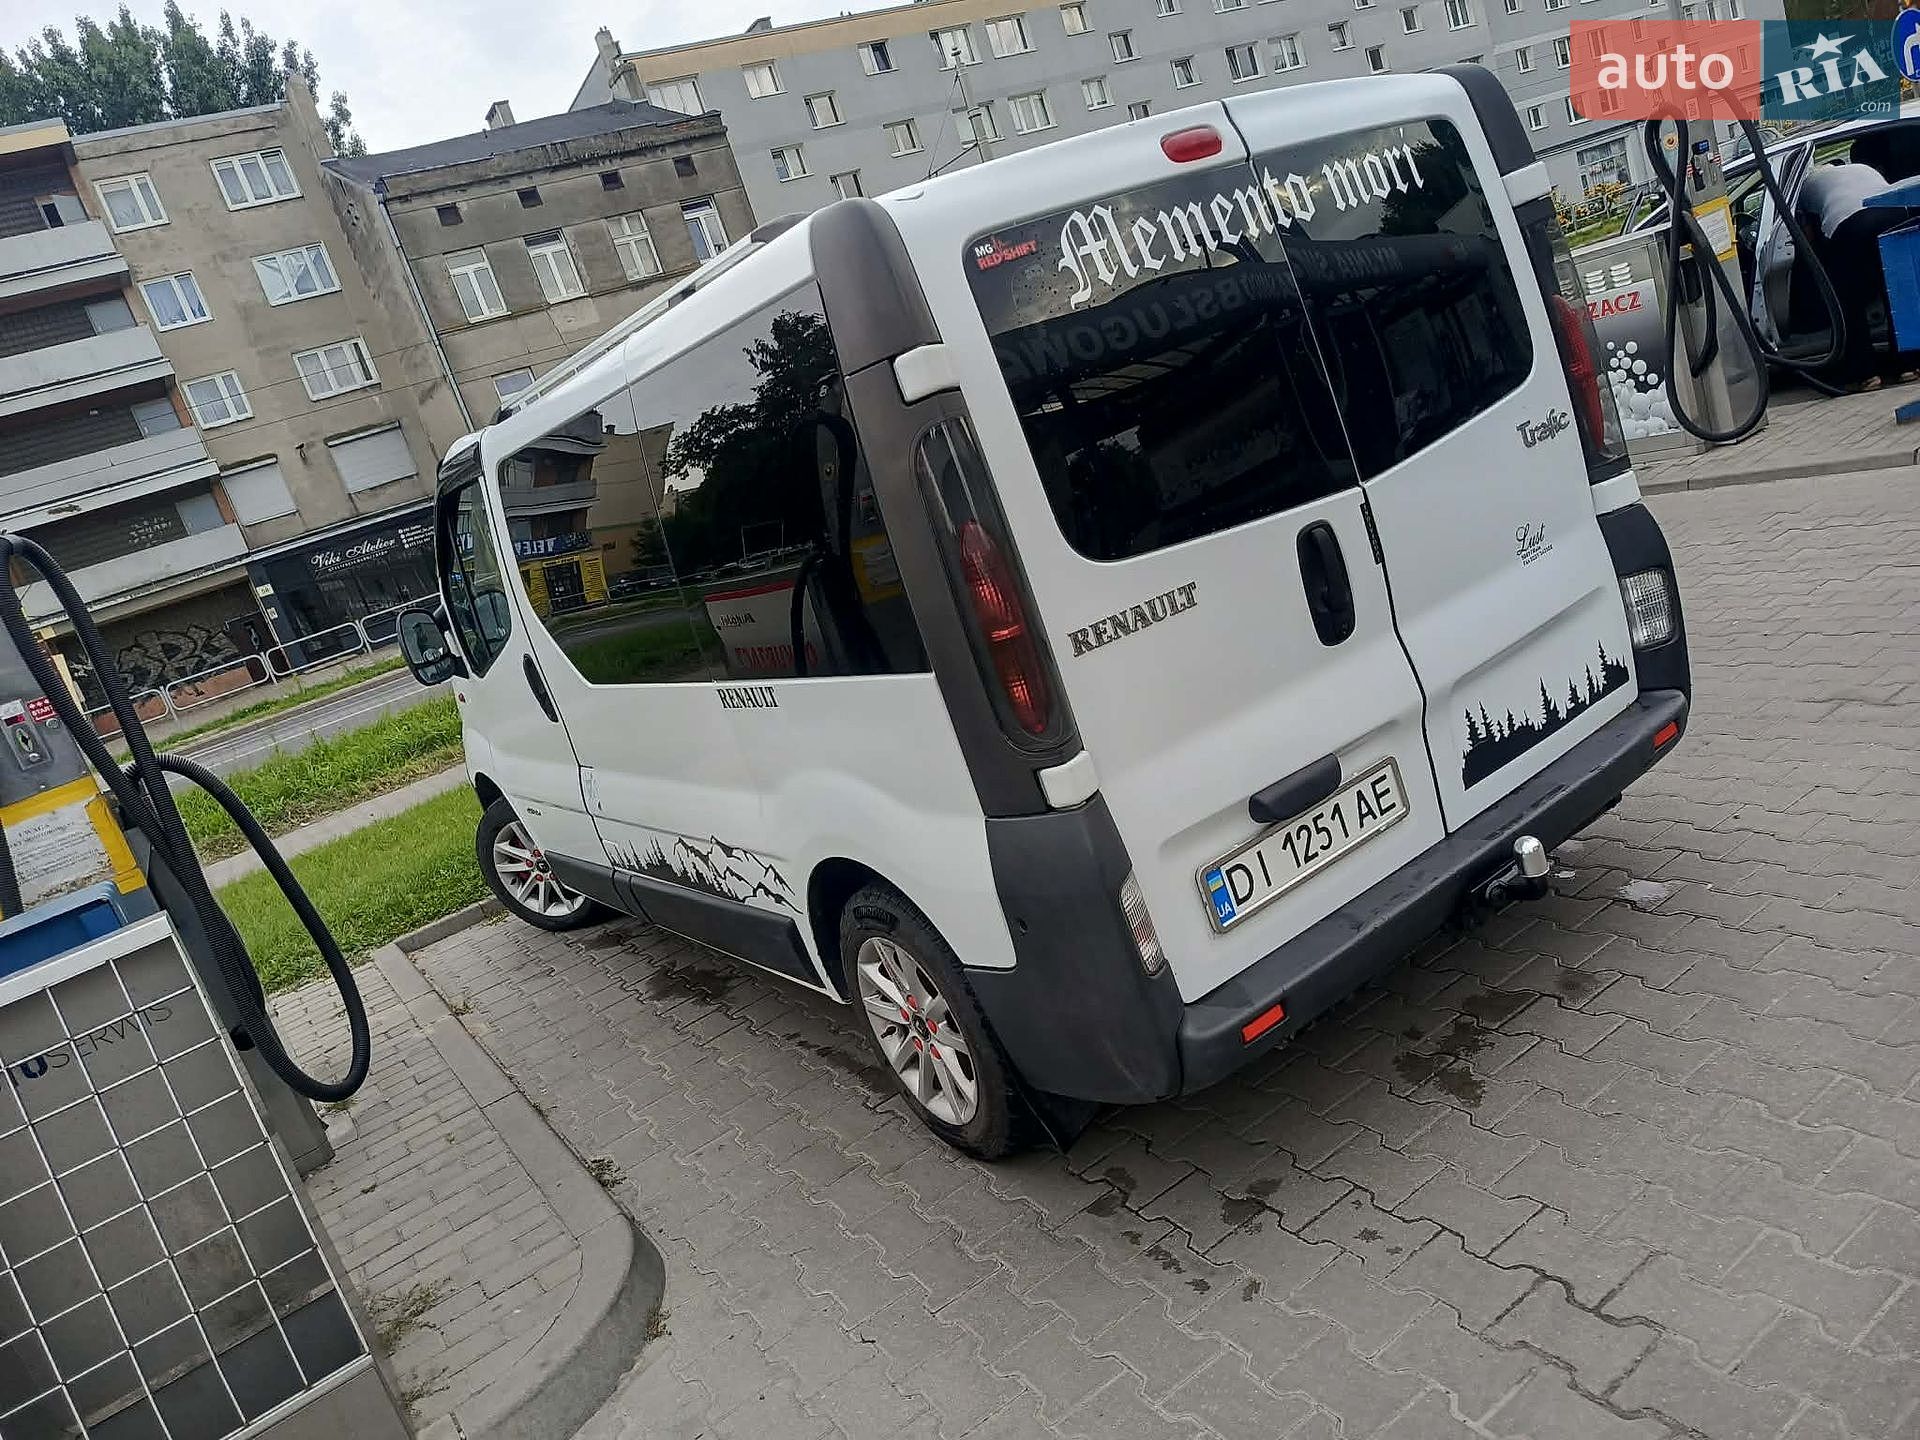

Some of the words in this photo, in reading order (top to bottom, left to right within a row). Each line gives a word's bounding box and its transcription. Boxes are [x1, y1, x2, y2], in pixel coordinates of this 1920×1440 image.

[1057, 163, 1317, 309] Memento
[1321, 143, 1424, 212] mori
[976, 244, 994, 258] MG
[1516, 409, 1570, 448] Trafic
[1515, 523, 1545, 555] Lust
[311, 551, 341, 567] Viki
[1066, 581, 1198, 658] RENAULT
[716, 686, 780, 709] RENAULT
[1225, 850, 1272, 907] DI
[1282, 803, 1350, 868] 1251
[1355, 774, 1397, 829] AE
[1217, 896, 1233, 918] UA
